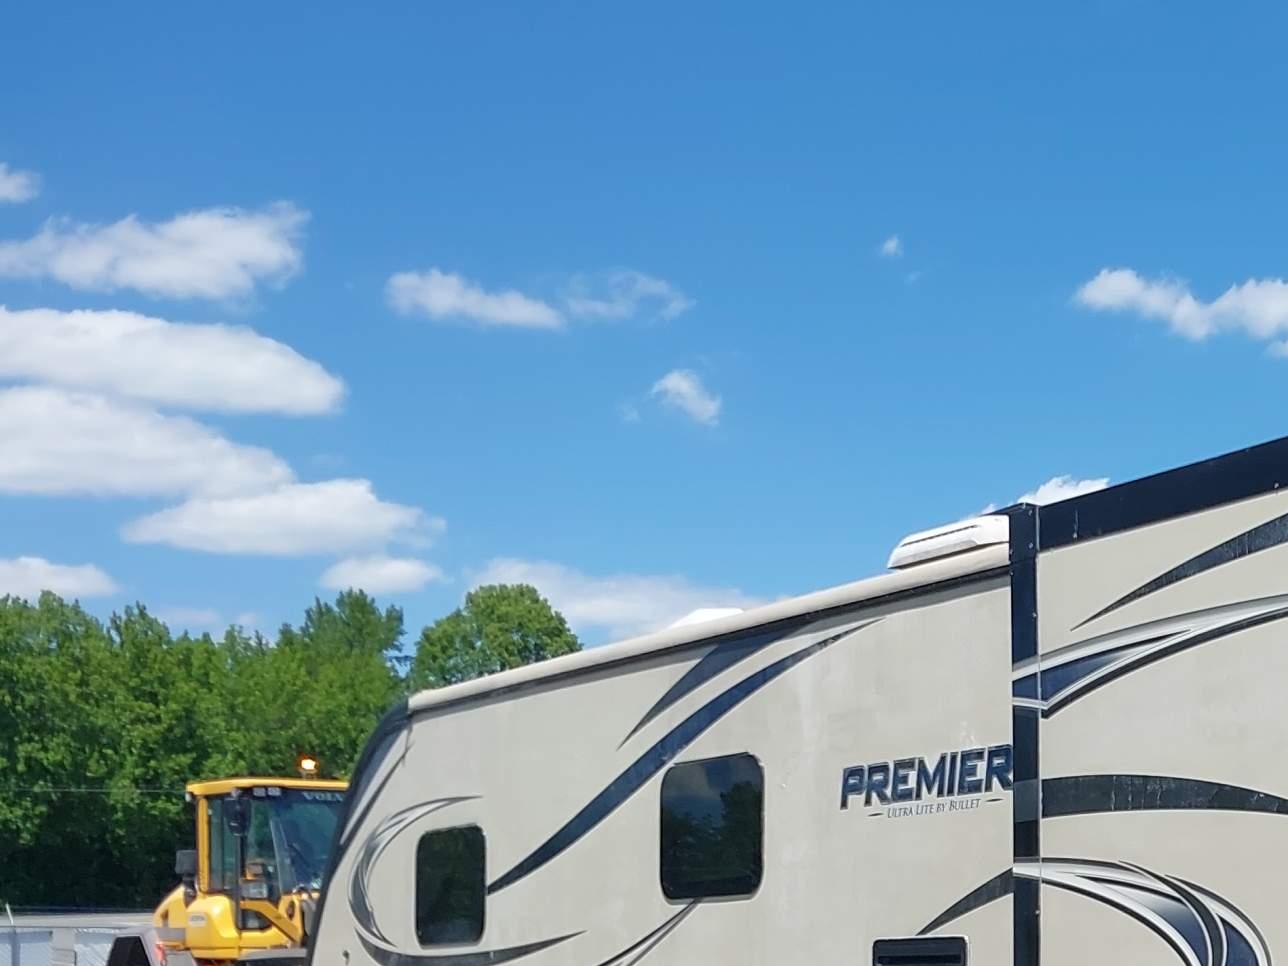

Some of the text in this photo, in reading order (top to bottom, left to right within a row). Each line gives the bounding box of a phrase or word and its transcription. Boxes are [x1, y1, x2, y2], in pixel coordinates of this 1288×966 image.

[840, 744, 1013, 810] PREMIER
[887, 807, 914, 818] ULTRA
[915, 803, 935, 816] LITE
[949, 798, 981, 811] BULLET
